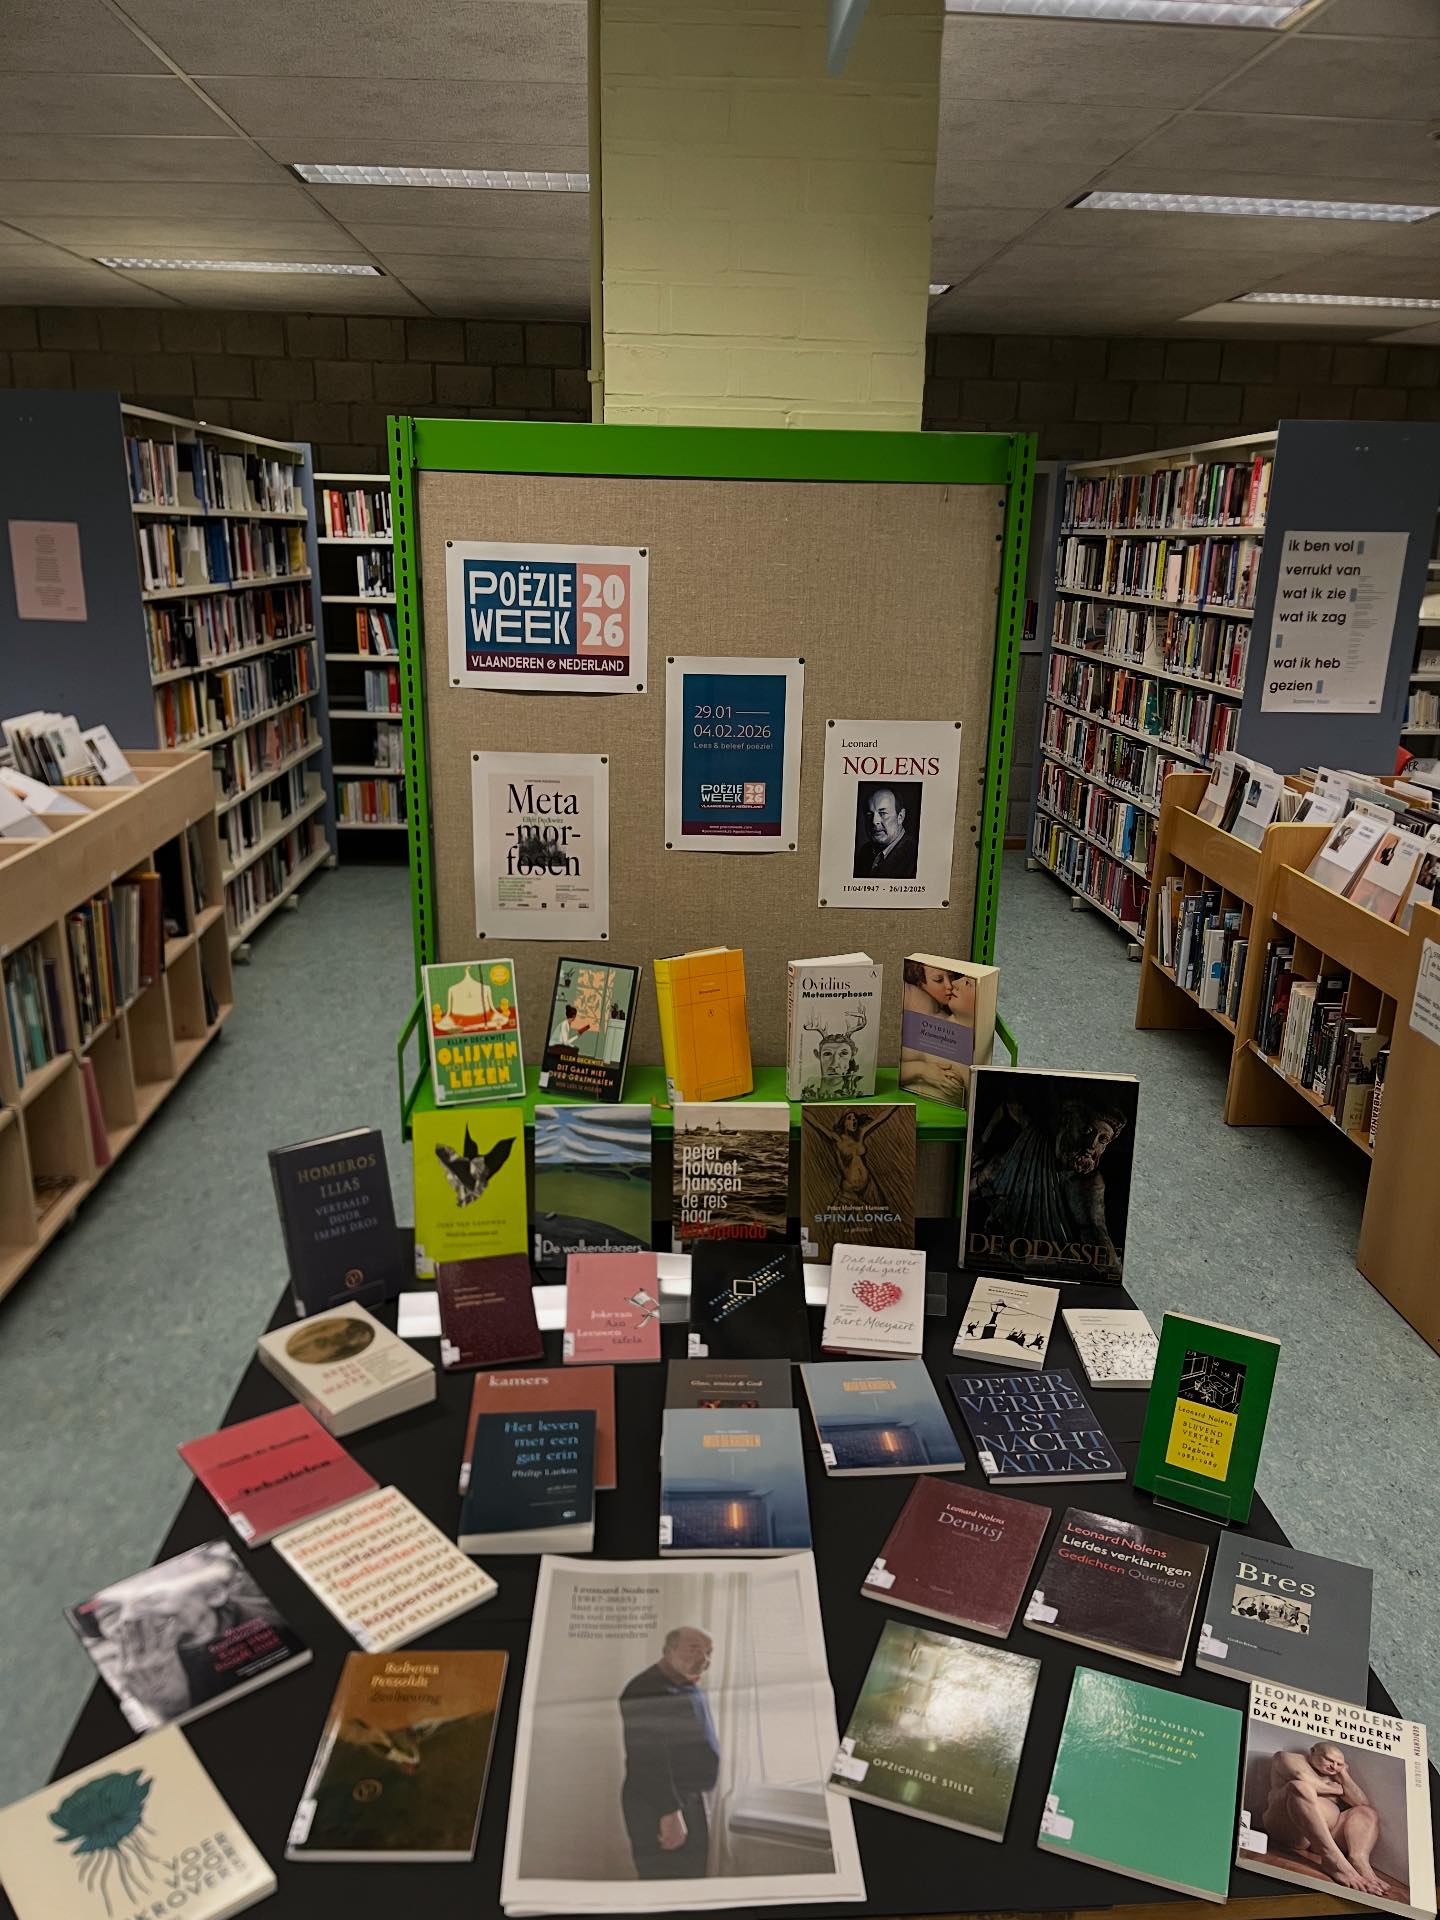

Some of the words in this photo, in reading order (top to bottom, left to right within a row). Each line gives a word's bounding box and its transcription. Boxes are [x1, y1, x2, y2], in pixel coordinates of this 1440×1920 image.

[1288, 539, 1300, 551] ik
[1303, 540, 1330, 552] ben
[1334, 540, 1355, 552] vol
[1286, 564, 1332, 576] verrukt
[1336, 565, 1361, 576] van
[469, 565, 572, 608] POËZIE
[582, 573, 625, 609] 20
[1283, 588, 1307, 599] wat
[1311, 588, 1322, 599] ik
[1327, 588, 1346, 599] zie
[470, 608, 571, 645] WEEK
[1279, 611, 1304, 623] wat
[1307, 611, 1317, 623] ik
[1321, 612, 1347, 626] zag
[582, 612, 624, 648] 26
[471, 655, 544, 669] VLAANDEREN
[546, 659, 556, 669] &
[559, 660, 624, 672] NEDERLAND
[1273, 657, 1297, 668] wat
[1300, 658, 1311, 668] ik
[1315, 658, 1341, 668] heb
[1269, 679, 1313, 694] gezien
[694, 705, 732, 719] 29.01
[693, 724, 771, 738] 04.02.2026
[721, 742, 745, 750] beleef
[841, 739, 878, 748] Leonard
[843, 756, 940, 776] NOLENS
[700, 783, 742, 794] POËZIE
[701, 793, 742, 803] WEEK
[746, 784, 763, 793] 20
[746, 793, 763, 803] 26
[507, 783, 580, 815] Meta
[506, 845, 582, 877] fosen
[889, 885, 926, 893] 26/12/2025
[802, 977, 851, 991] Ovidius
[437, 1040, 518, 1066] OLIJVEN
[449, 1066, 511, 1089] LEZEN
[557, 1063, 569, 1071] DIT
[570, 1065, 589, 1075] GAAT
[590, 1069, 607, 1077] NIET
[1370, 1081, 1381, 1135] REMBRANDT
[682, 1143, 722, 1162] peter
[297, 1153, 377, 1184] HOMEROS
[682, 1159, 744, 1176] holvoet-
[320, 1177, 361, 1199] ILIAS
[682, 1173, 742, 1192] hanssen
[315, 1195, 370, 1217] VERTAALD
[681, 1190, 699, 1209] de
[703, 1192, 728, 1209] reis
[329, 1209, 360, 1226] DOOR
[681, 1209, 713, 1223] naar
[814, 1213, 902, 1223] SPINALONGA
[543, 1240, 560, 1253] De
[563, 1239, 642, 1253] wolkendragers
[968, 1232, 1004, 1255] DE
[846, 1263, 878, 1274] liefde
[882, 1266, 910, 1278] gaat
[895, 1258, 920, 1266] over
[832, 1315, 862, 1325] Bart
[488, 1375, 549, 1387] kamers
[962, 1374, 1072, 1395] PETER
[960, 1391, 1085, 1413] VERHE
[504, 1421, 533, 1433] Het
[538, 1420, 579, 1431] leven
[1001, 1412, 1062, 1433] LST
[514, 1437, 544, 1447] met
[550, 1437, 579, 1445] een
[975, 1430, 1104, 1453] NACHT
[1182, 1429, 1221, 1446] VERTREK
[516, 1452, 541, 1465] gat
[546, 1450, 577, 1461] erin
[1000, 1450, 1112, 1474] ATLAS
[512, 1468, 543, 1479] Philip
[945, 1503, 978, 1518] Leonard
[977, 1512, 1006, 1525] Nolens
[937, 1511, 1005, 1542] Derwisj
[1066, 1522, 1121, 1545] Leonard
[1120, 1538, 1168, 1559] Nolens
[1062, 1534, 1108, 1555] Liefdes
[1110, 1550, 1192, 1577] verklaringen
[1057, 1548, 1125, 1575] Gedichten
[1128, 1568, 1186, 1589] Querido
[1235, 1561, 1317, 1598] Bres
[1255, 1684, 1333, 1713] LEONARD
[1337, 1706, 1405, 1733] NOLENS
[1159, 1718, 1206, 1739] NOLENS
[1253, 1707, 1276, 1721] DAT
[1281, 1715, 1302, 1728] WIJ
[1306, 1722, 1335, 1737] NIET
[1340, 1731, 1393, 1752] DEUGEN
[1254, 1697, 1278, 1711] ZEG
[1282, 1705, 1310, 1719] AAN
[1314, 1713, 1330, 1725] DE
[1335, 1718, 1402, 1743] KINDEREN
[1120, 1731, 1199, 1760] ANTWERPEN
[1138, 1725, 1196, 1747] DICHTER
[1411, 1725, 1421, 1757] GEDICHTEN
[872, 1757, 938, 1784] OPZICHTIGE
[941, 1777, 976, 1795] STILTE
